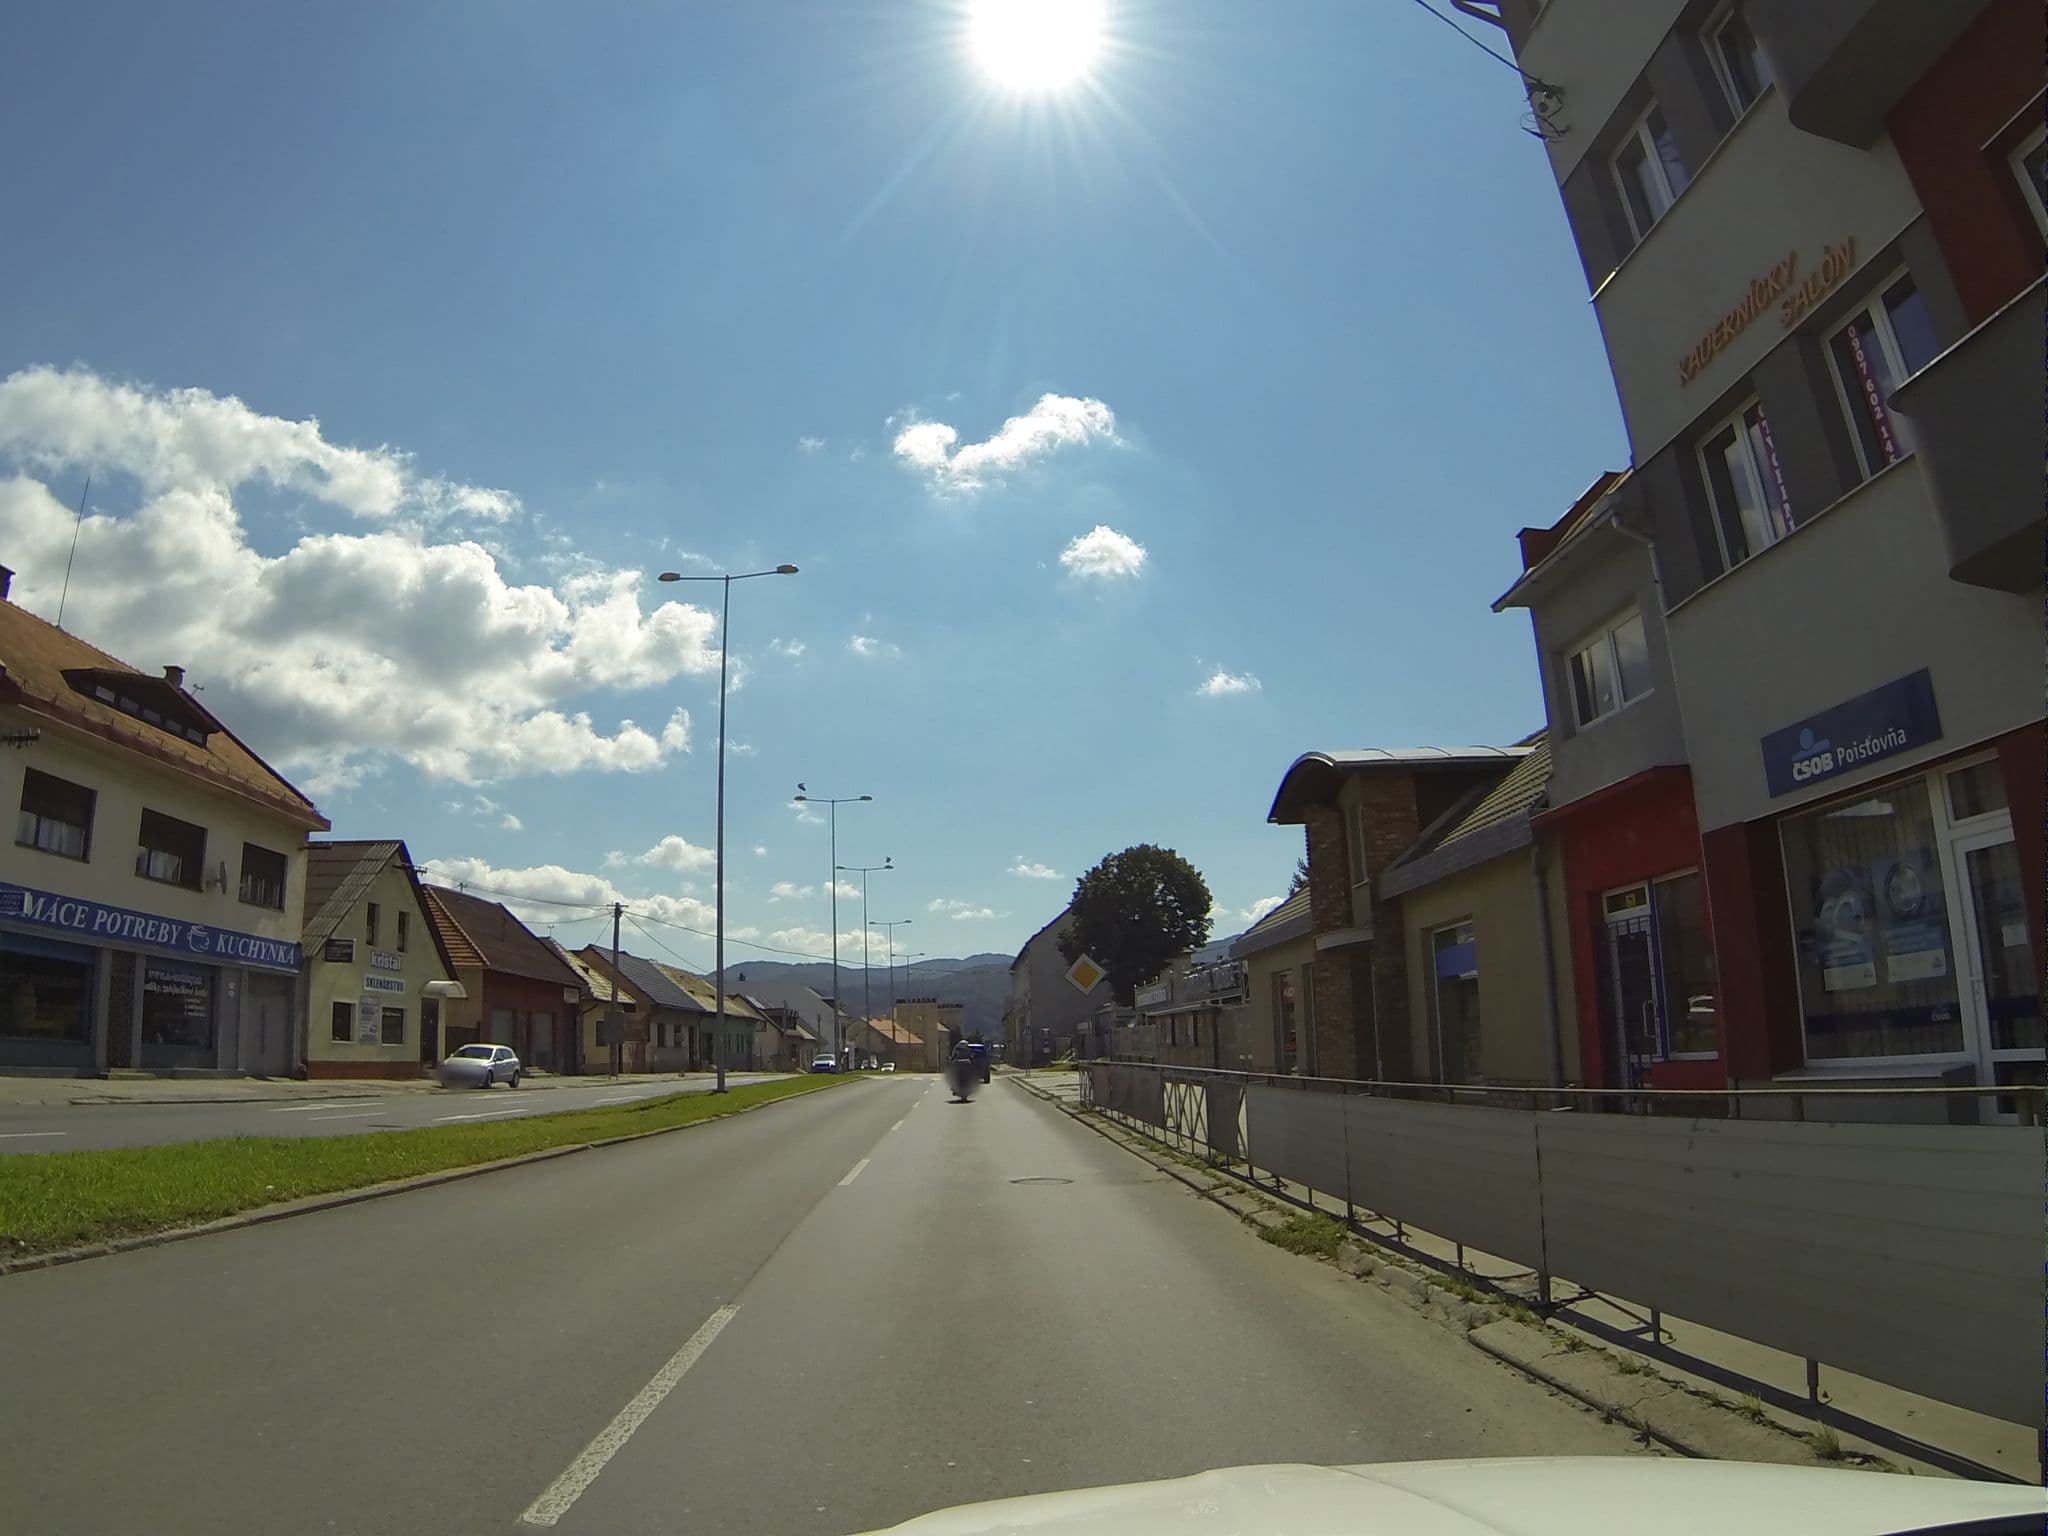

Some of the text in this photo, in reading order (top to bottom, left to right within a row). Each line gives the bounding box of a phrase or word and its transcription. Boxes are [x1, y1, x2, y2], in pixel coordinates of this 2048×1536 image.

[1848, 325, 1867, 375] 0907
[1865, 379, 1884, 420] 602
[1791, 727, 1907, 782] ČSOB Poisťovňa
[92, 907, 182, 946] POTREBY
[215, 935, 296, 965] KUCHYNKA
